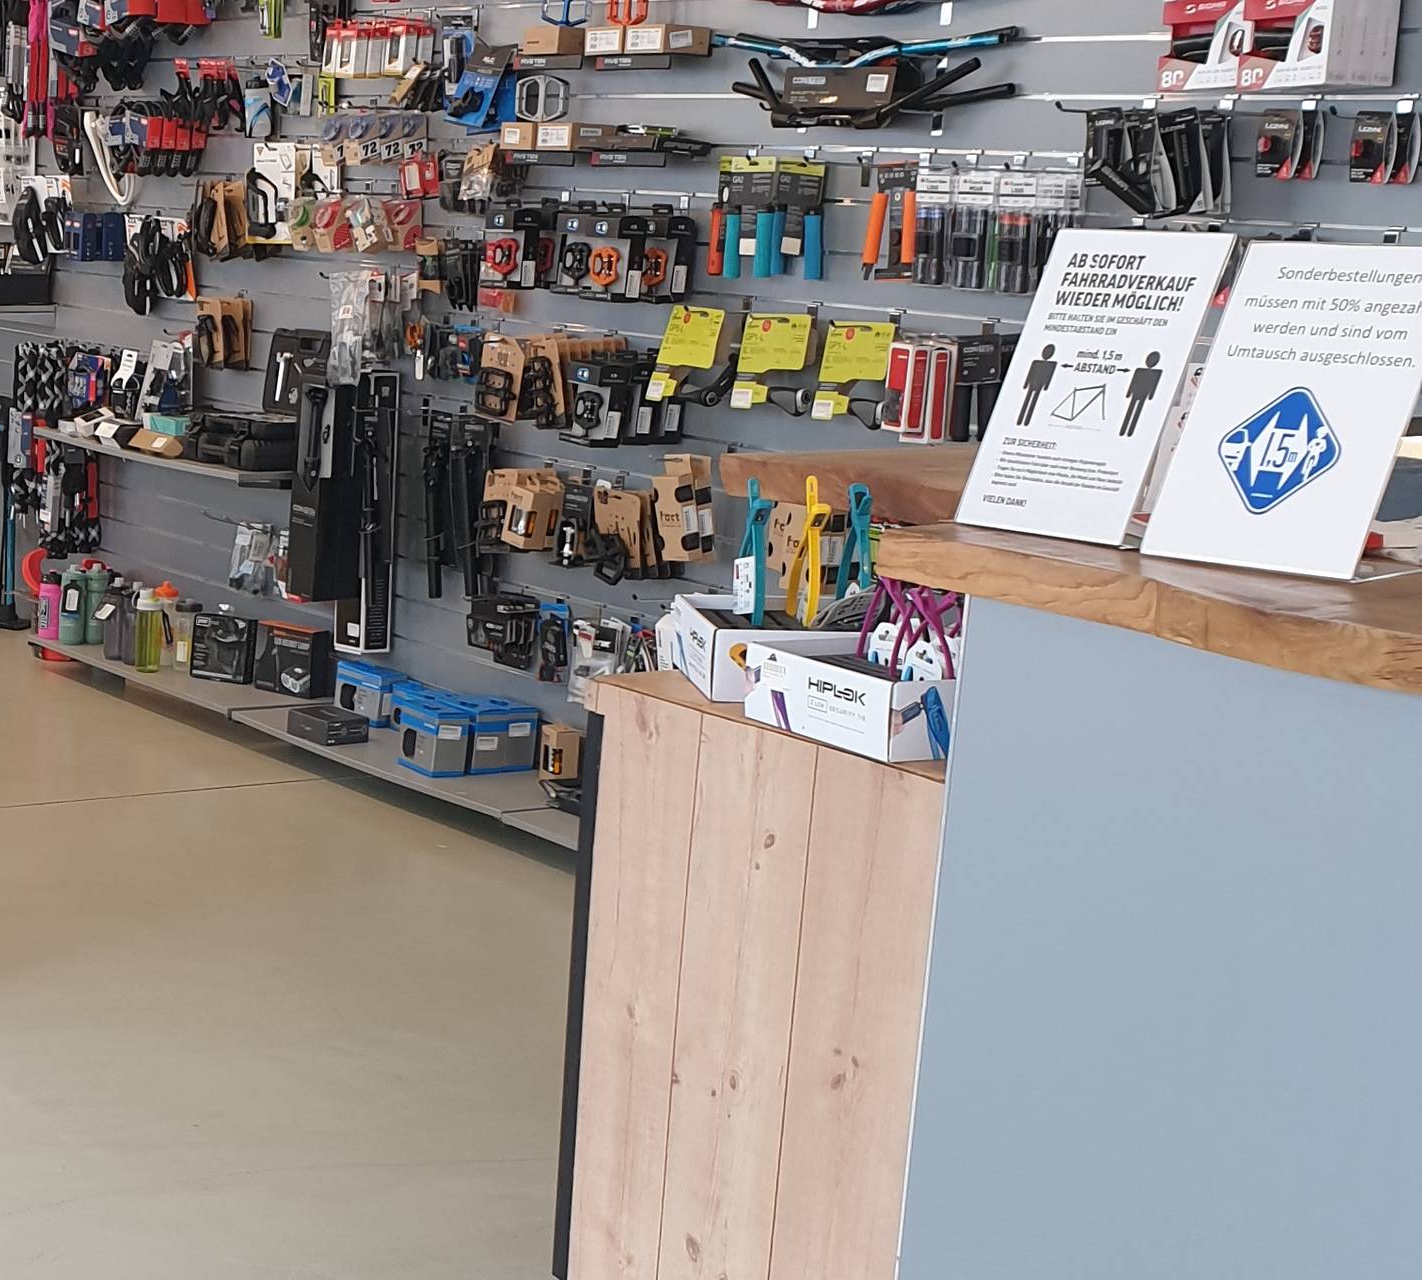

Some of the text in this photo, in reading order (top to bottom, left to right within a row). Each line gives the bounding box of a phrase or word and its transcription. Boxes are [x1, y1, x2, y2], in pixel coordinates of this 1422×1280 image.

[337, 144, 344, 158] 7
[362, 141, 378, 157] 72
[385, 142, 400, 156] 72
[1067, 253, 1146, 270] AB SOFORT
[1060, 272, 1197, 292] FAHRRADVERKAUF
[1277, 266, 1422, 287] Sonderbestellungen
[1055, 290, 1185, 312] WIEDER MÖGLICH!
[1244, 295, 1298, 310] müssen
[1301, 297, 1327, 311] mit
[1329, 298, 1361, 312] 50%
[1047, 312, 1067, 321] BITTE
[1067, 313, 1094, 322] HALTEN
[1095, 315, 1106, 323] SIE
[1153, 318, 1169, 326] DEN
[1105, 327, 1118, 335] EIN
[1253, 321, 1408, 341] werden und sind vom
[1102, 350, 1115, 360] 1,5
[1227, 344, 1417, 369] Umtausch ausgeschlossen.
[1074, 362, 1117, 374] ABSTAND
